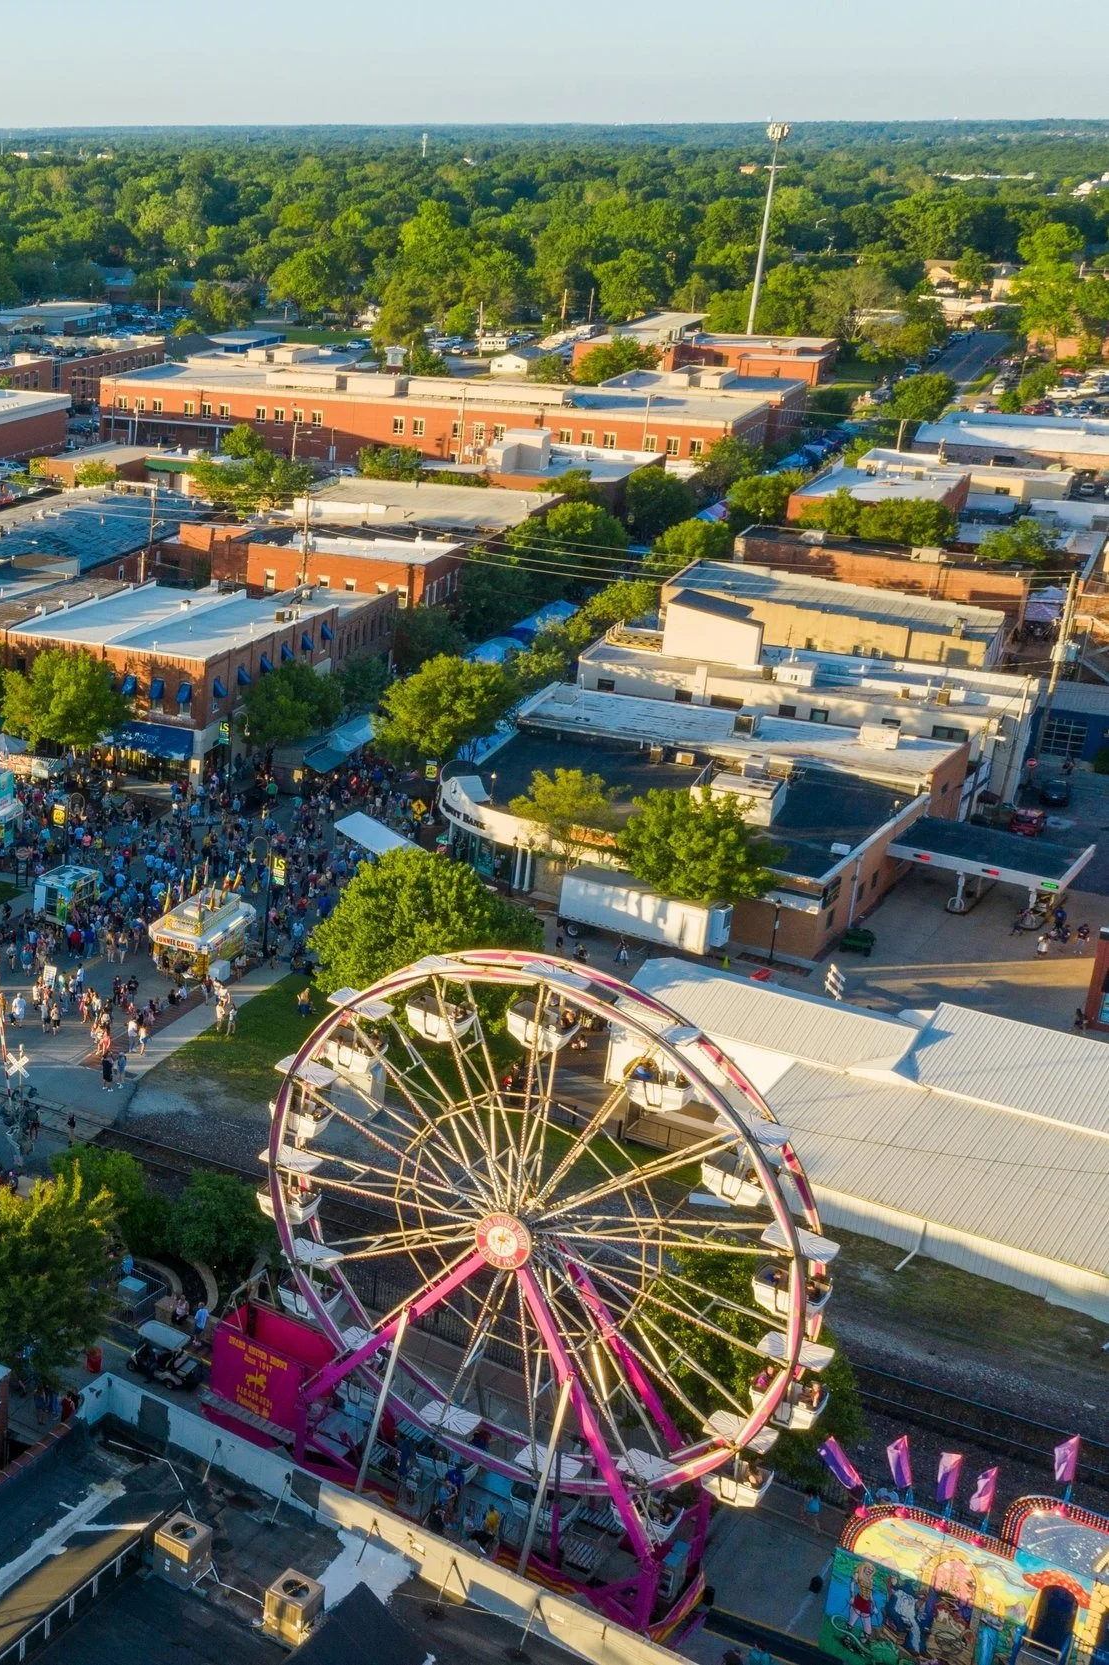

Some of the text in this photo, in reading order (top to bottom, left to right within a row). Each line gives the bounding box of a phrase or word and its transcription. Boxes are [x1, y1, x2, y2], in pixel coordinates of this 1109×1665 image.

[219, 722, 229, 731] LS
[274, 857, 285, 870] LS
[176, 940, 195, 950] CAKES
